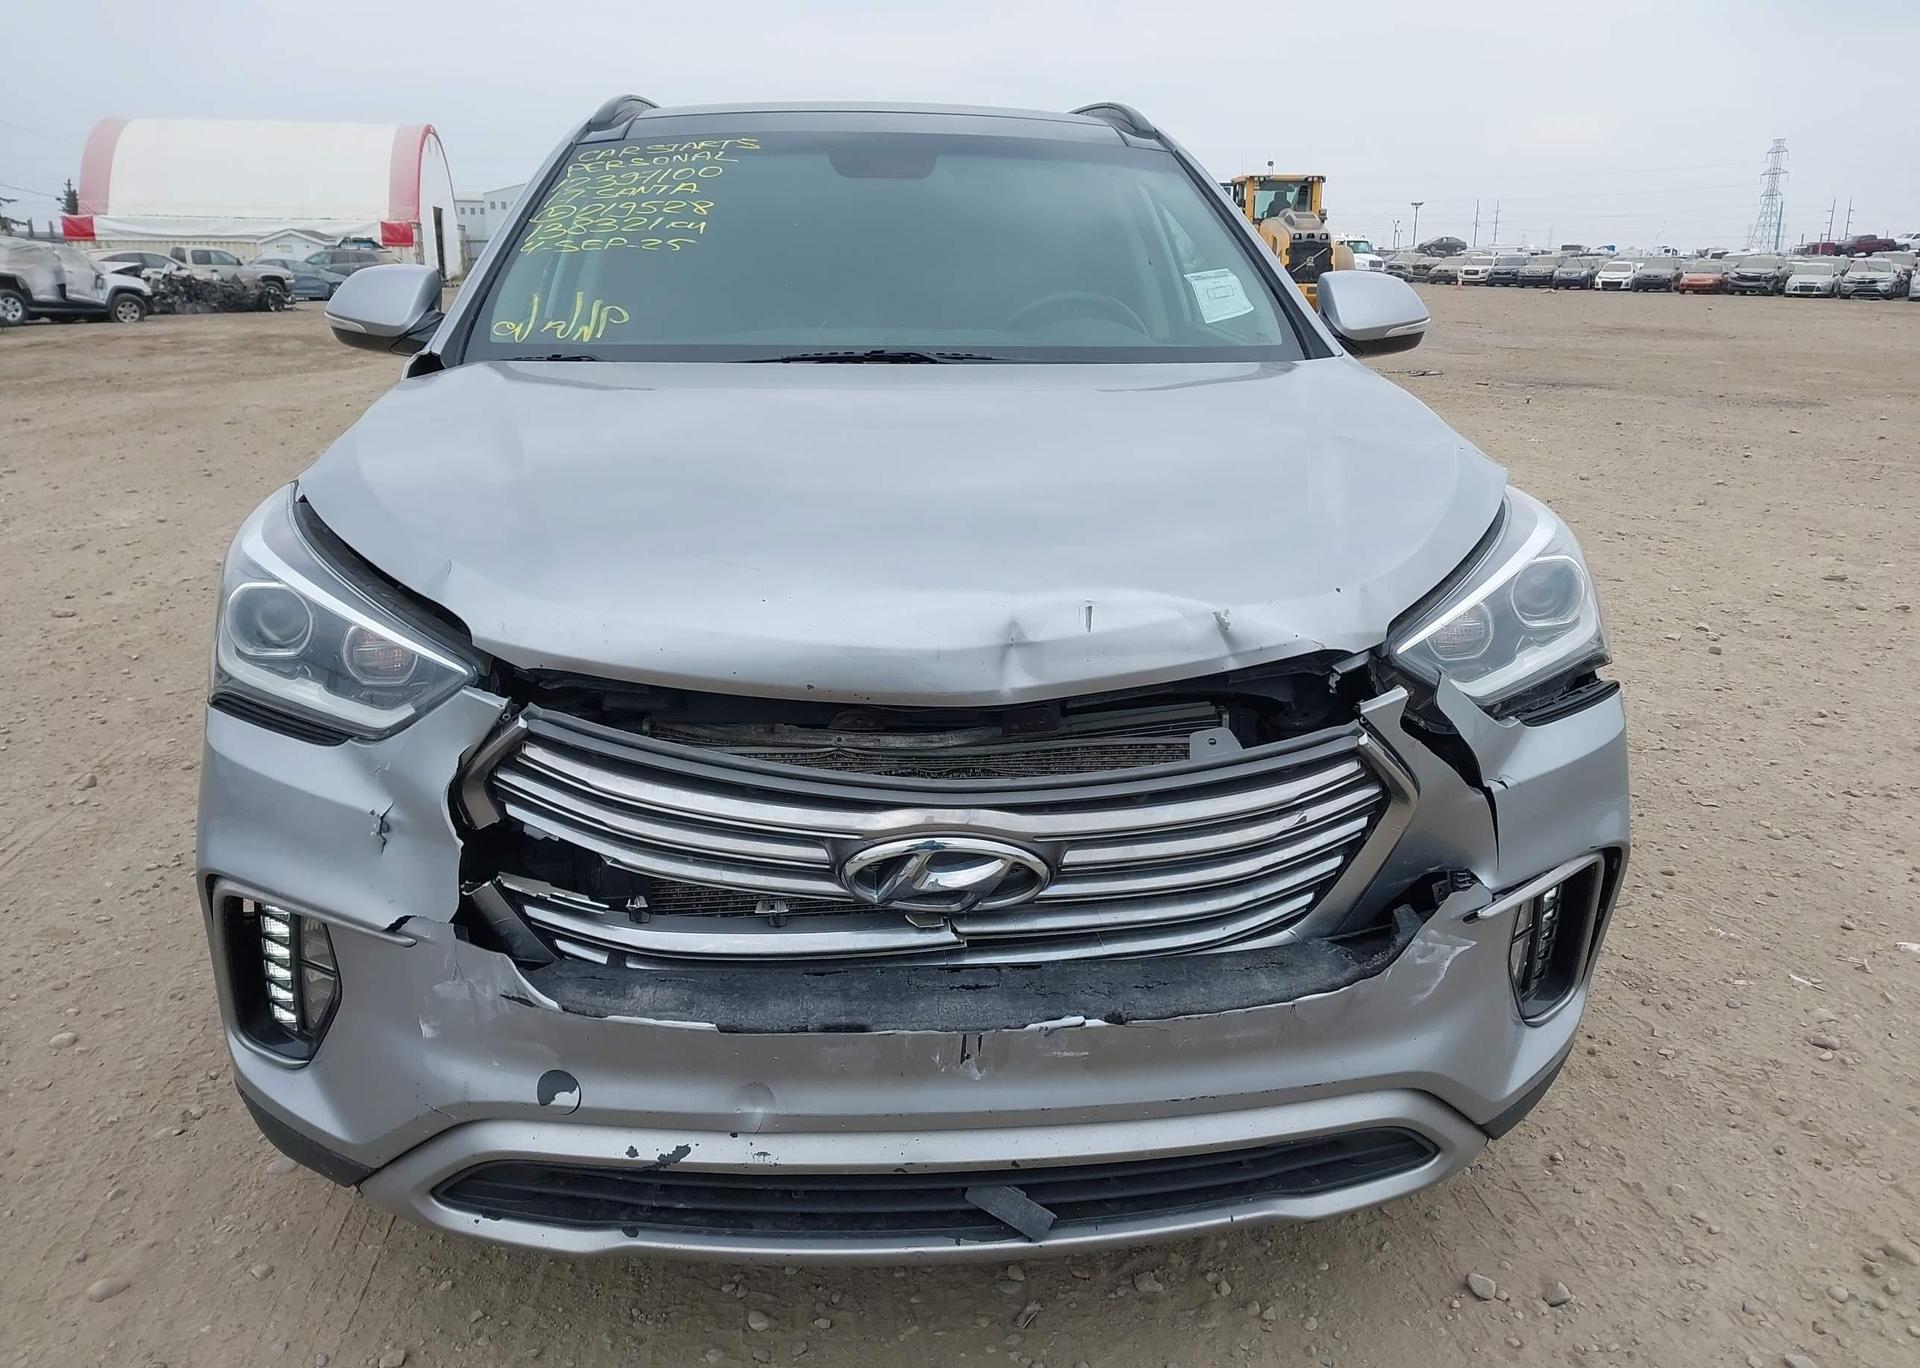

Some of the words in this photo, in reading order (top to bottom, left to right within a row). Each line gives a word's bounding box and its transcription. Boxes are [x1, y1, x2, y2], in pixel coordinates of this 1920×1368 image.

[578, 145, 640, 162] CAR
[647, 137, 761, 154] STARTS
[566, 150, 740, 178] PERSONAL
[591, 182, 701, 200] SANTA
